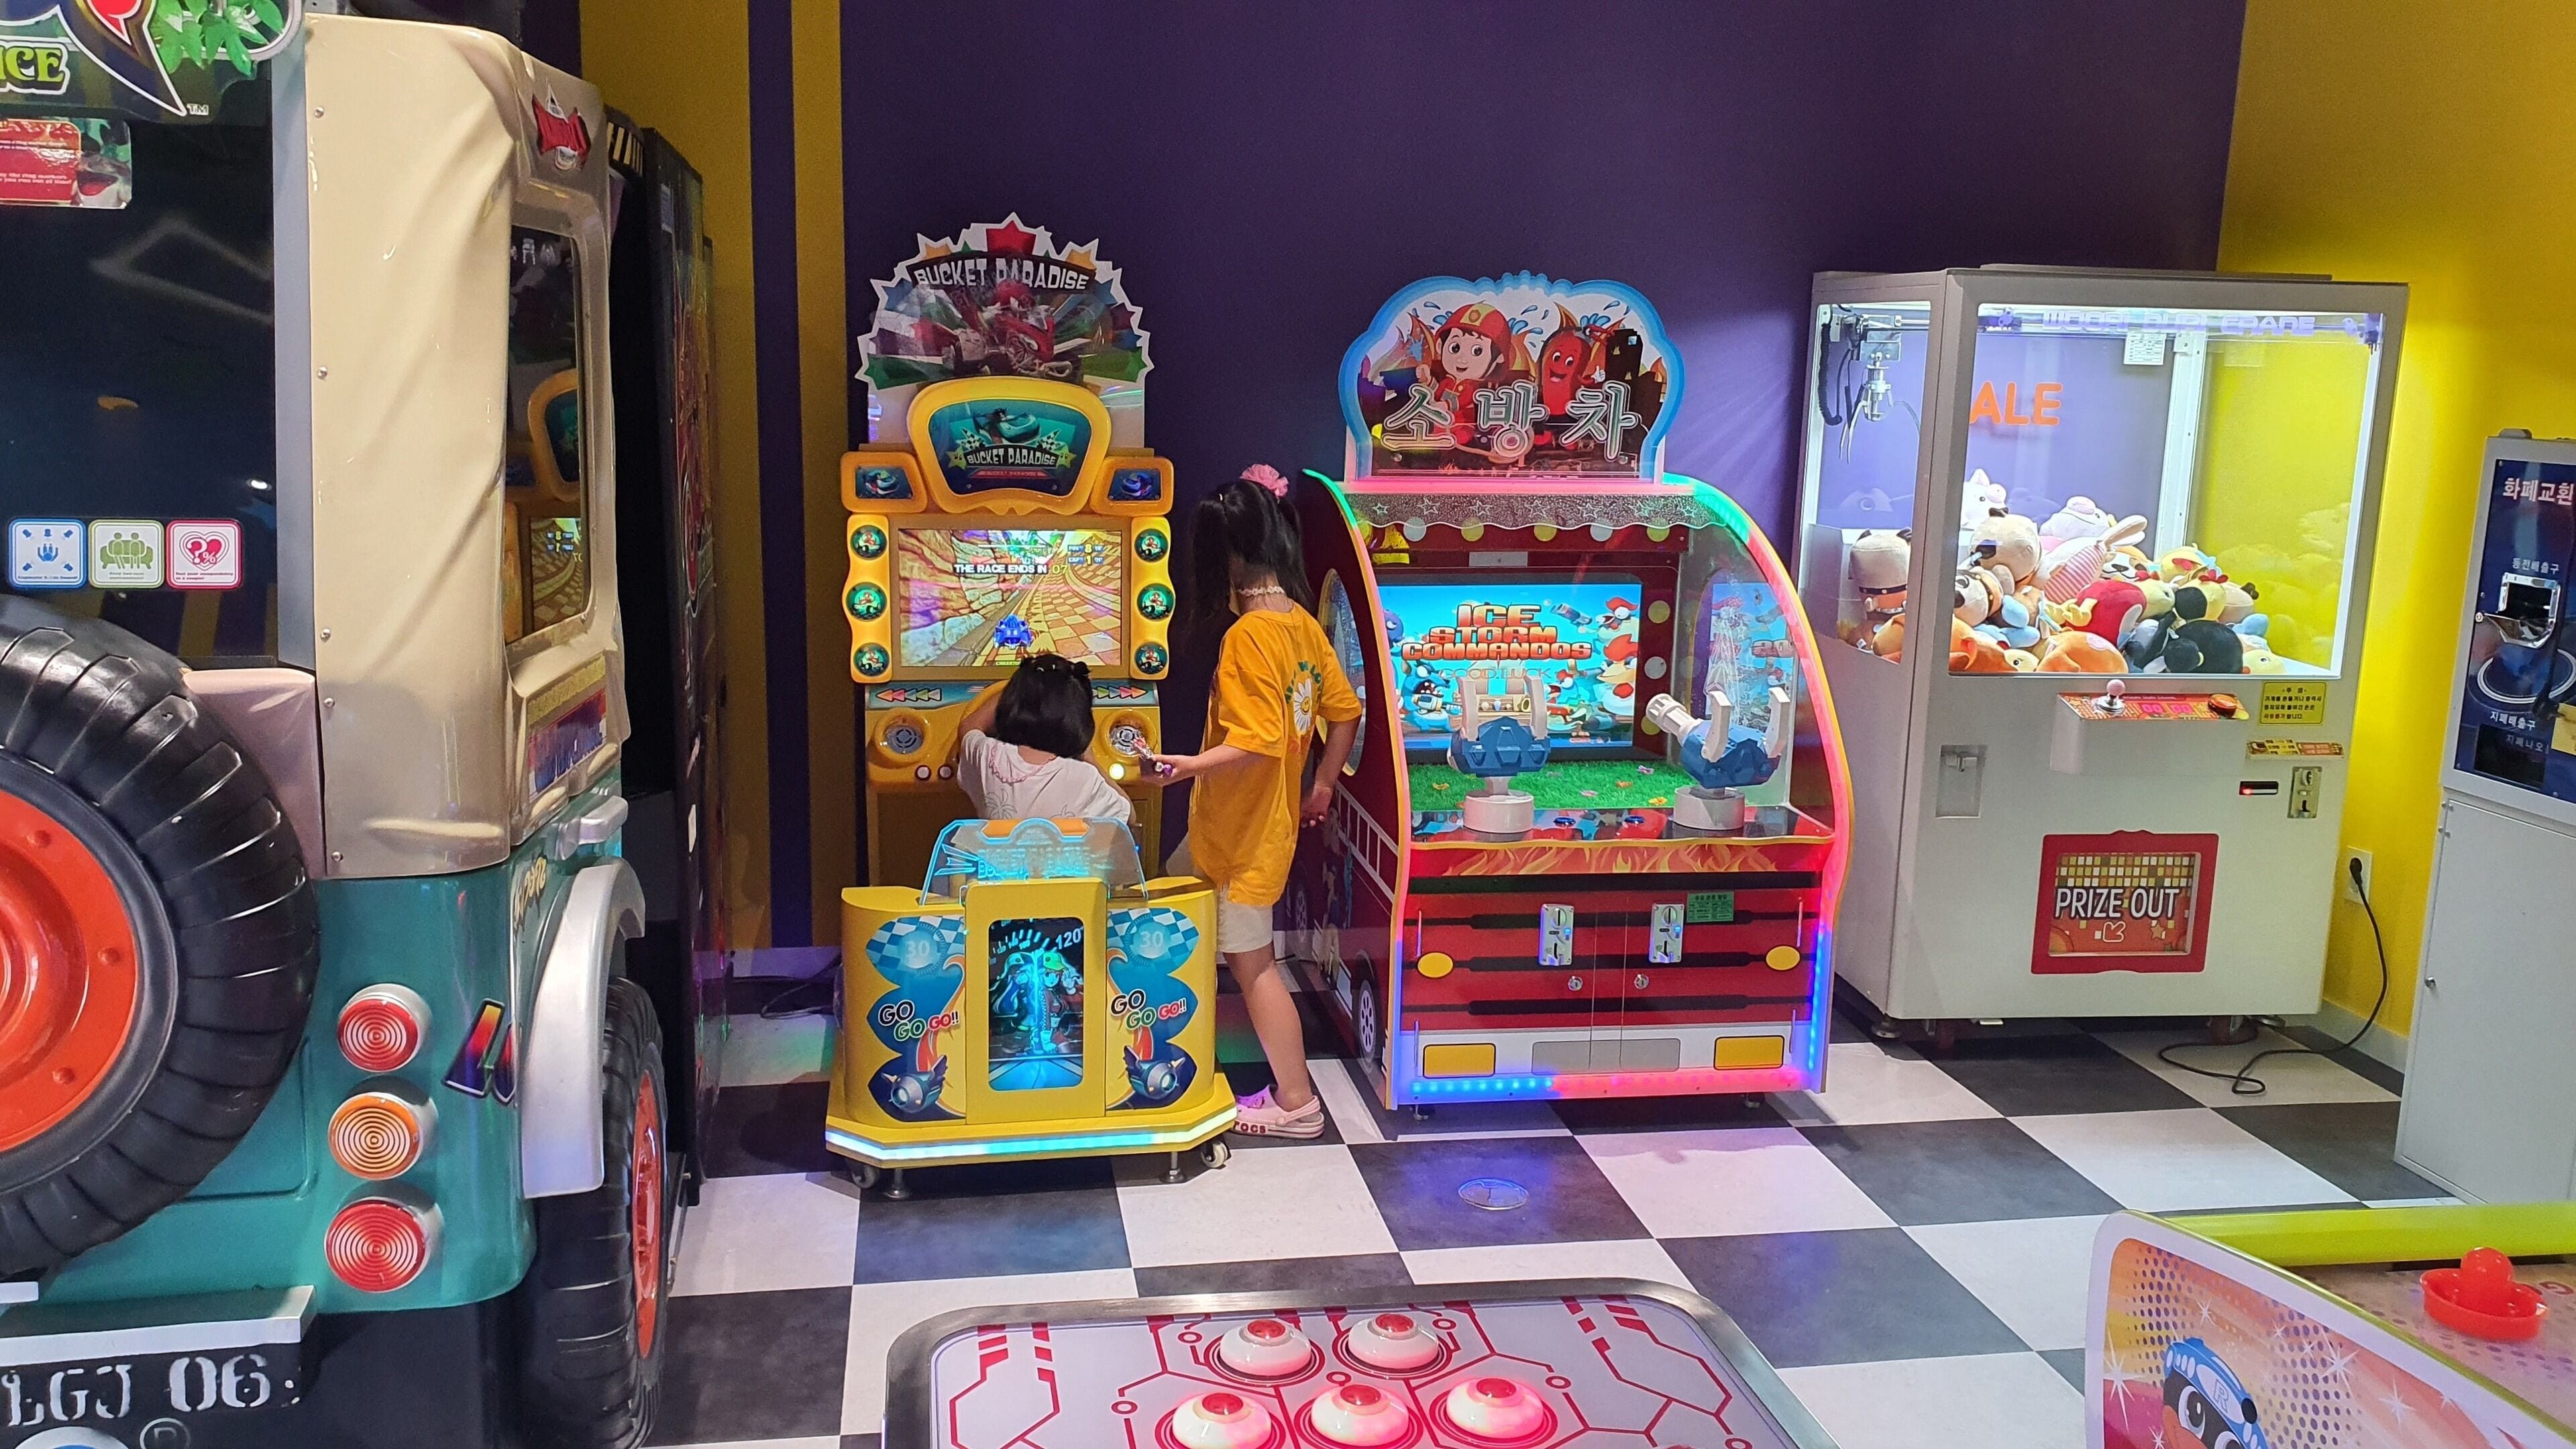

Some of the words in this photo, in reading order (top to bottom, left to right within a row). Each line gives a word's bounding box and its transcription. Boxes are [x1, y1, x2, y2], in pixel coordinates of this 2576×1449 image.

[0, 46, 65, 81] CE
[187, 103, 209, 115] TM
[914, 258, 987, 287] BUCKET
[996, 258, 1089, 290] PARADISE
[967, 447, 1005, 464] BUCKET
[1008, 447, 1057, 466] PARADISE
[1084, 543, 1092, 553] 8
[954, 564, 975, 574] THE
[977, 564, 1006, 574] RACE
[1008, 564, 1035, 574] ENDS
[1037, 565, 1047, 574] IN
[1052, 565, 1069, 574] 07
[1457, 604, 1542, 627] ICE
[1429, 626, 1557, 643] STORM
[1401, 642, 1593, 660] COMMANDOS
[2055, 888, 2124, 918] PRIZE
[2131, 888, 2180, 918] OUT
[878, 1000, 914, 1026] GO
[1111, 989, 1146, 1016] GO
[1126, 1007, 1157, 1030] GO
[1158, 998, 1187, 1019] GO!!
[894, 1019, 926, 1041] GO
[928, 1011, 959, 1030] GO!!
